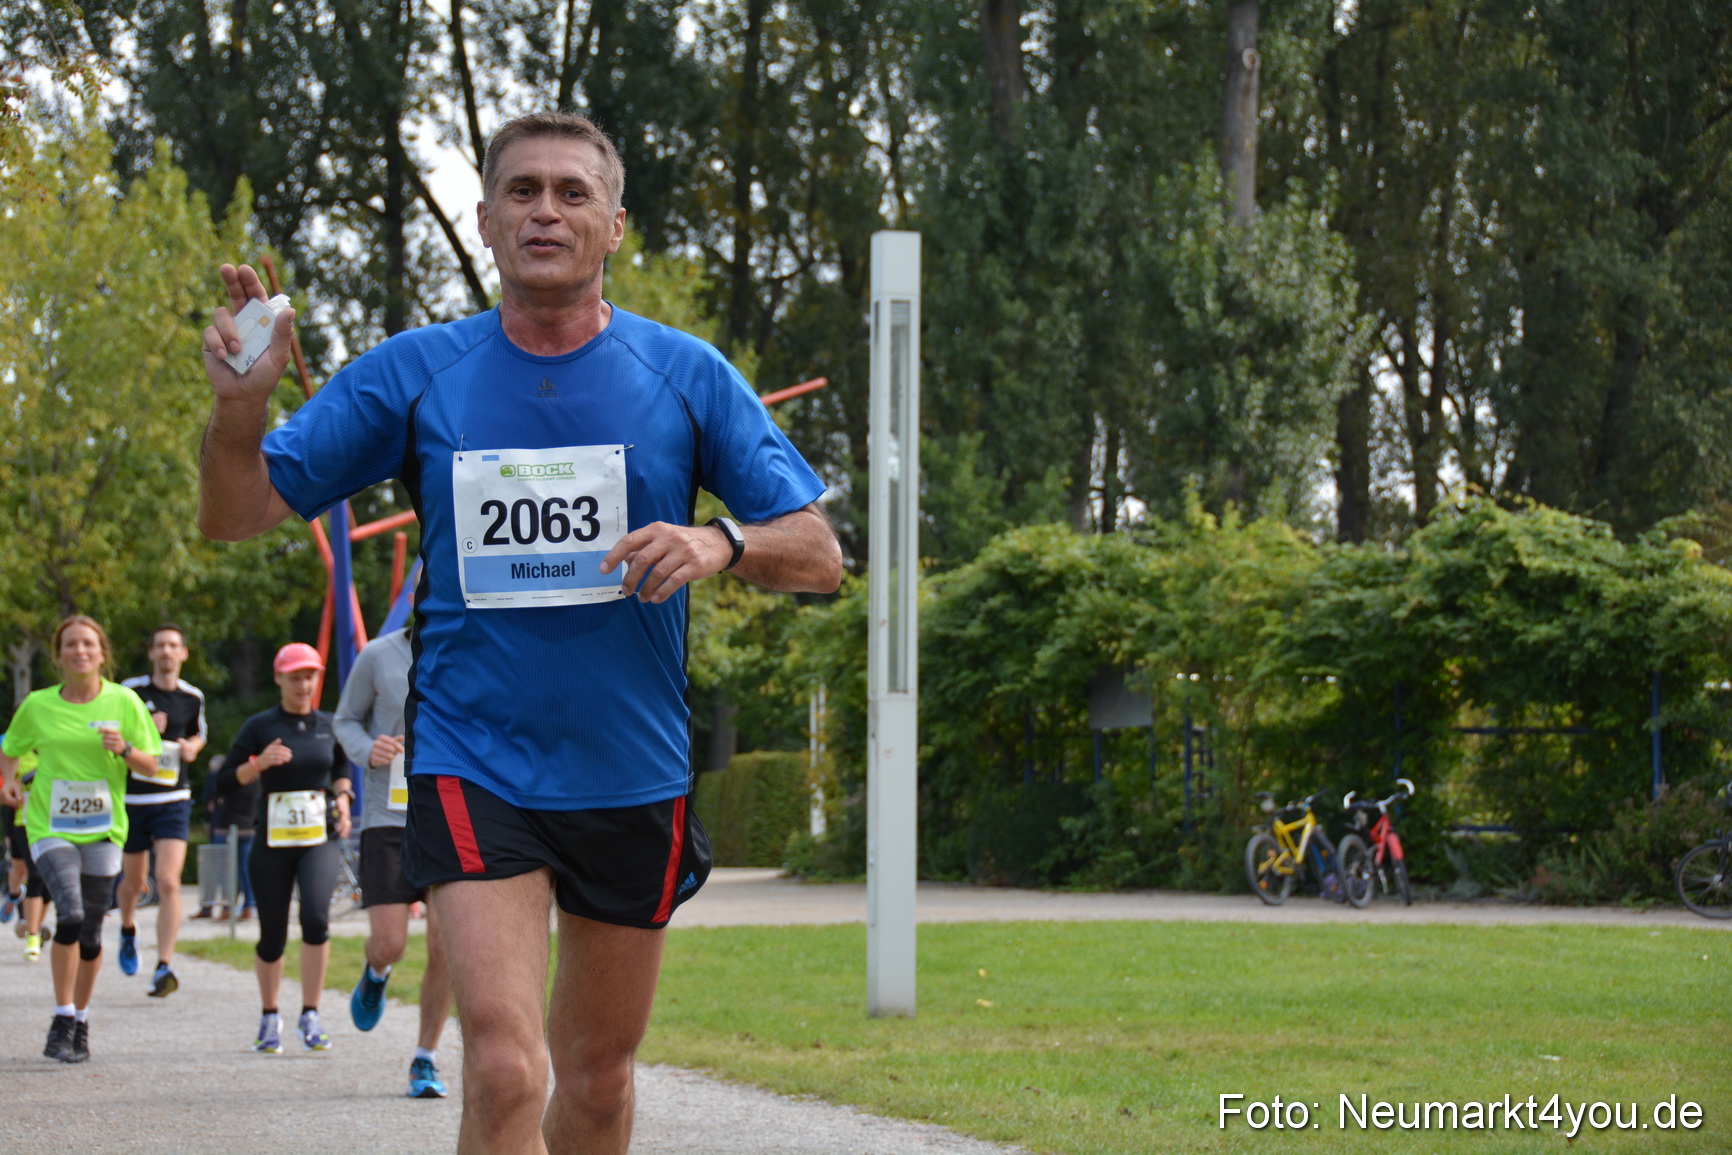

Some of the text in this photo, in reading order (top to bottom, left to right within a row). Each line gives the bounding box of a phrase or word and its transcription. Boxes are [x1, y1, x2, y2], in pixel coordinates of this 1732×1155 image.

[517, 462, 575, 476] BOCK
[480, 496, 601, 546] 2063
[467, 541, 473, 550] C
[511, 561, 575, 579] Michael
[59, 797, 103, 814] 2429
[288, 809, 306, 825] 31
